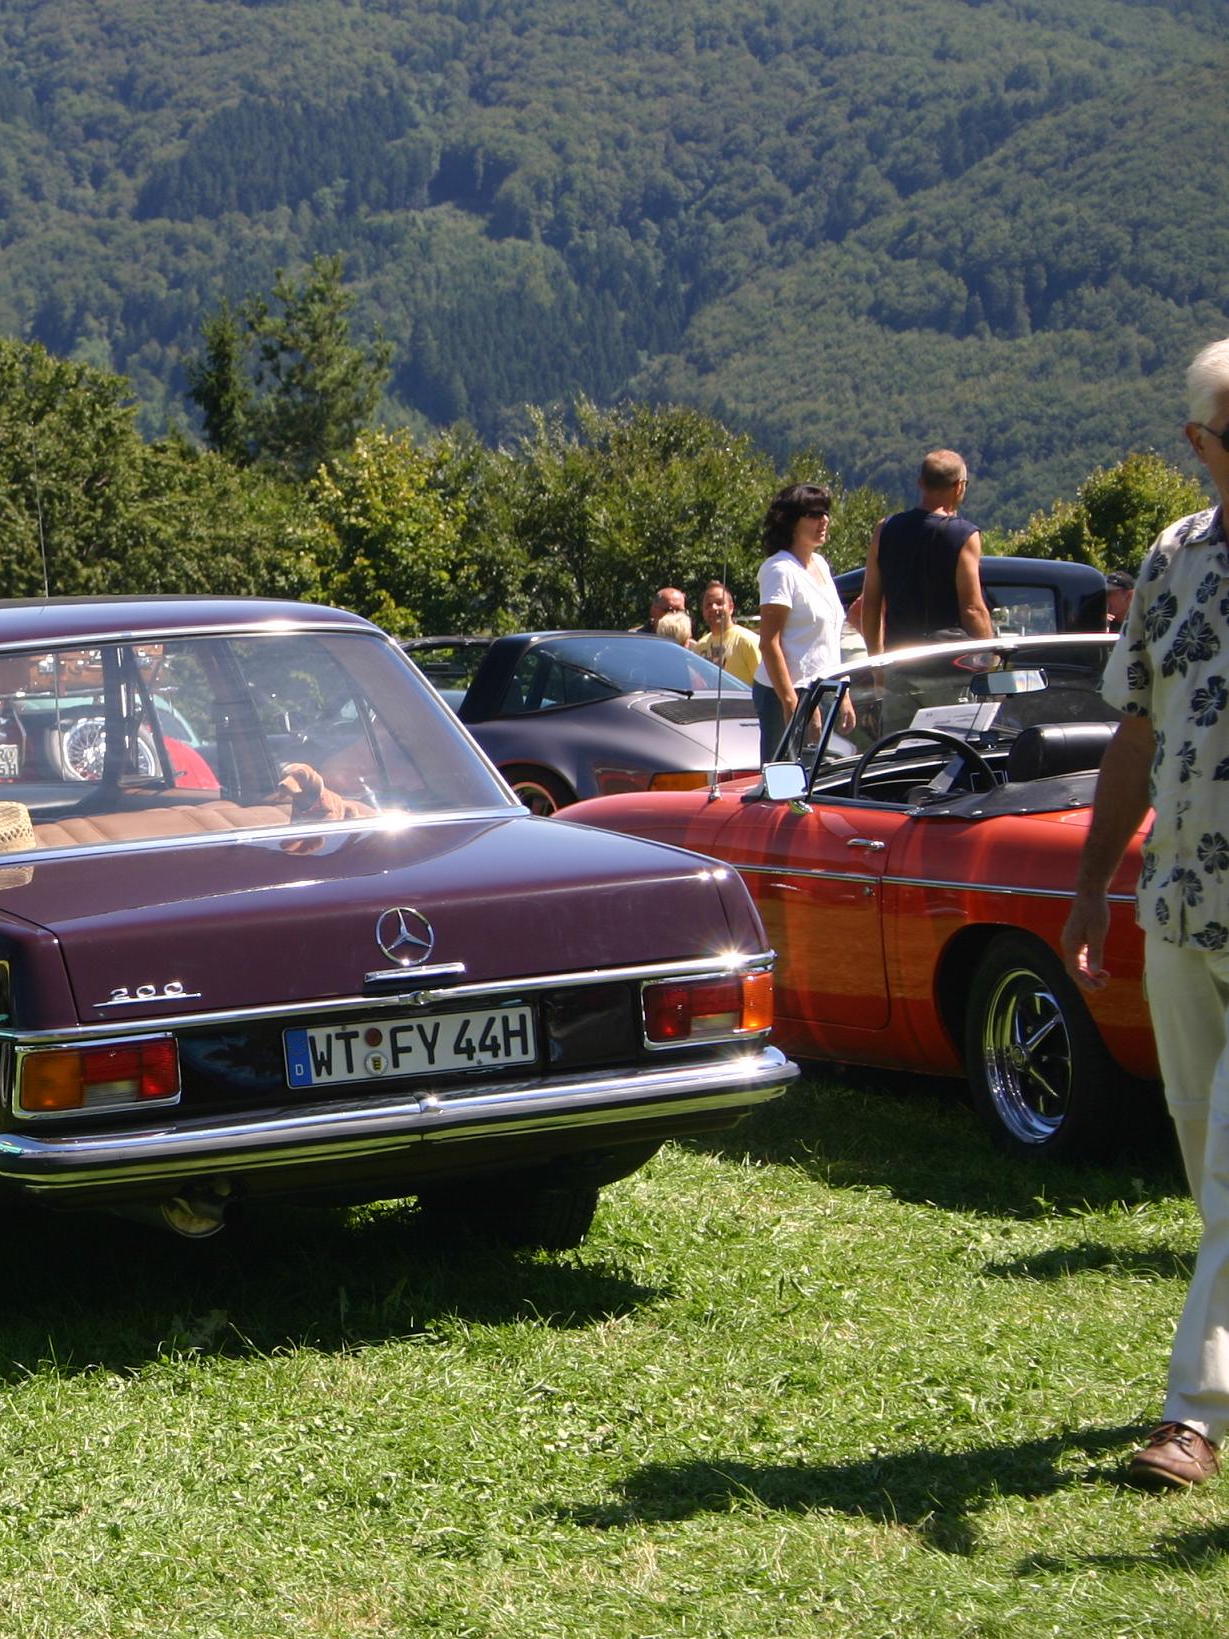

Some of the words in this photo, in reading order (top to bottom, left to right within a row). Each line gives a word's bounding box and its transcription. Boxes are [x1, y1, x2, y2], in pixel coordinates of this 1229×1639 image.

[110, 981, 184, 1001] 200
[295, 1063, 304, 1076] D
[308, 1031, 359, 1077] WT
[389, 1022, 440, 1069] FY
[453, 1013, 529, 1060] 44H
